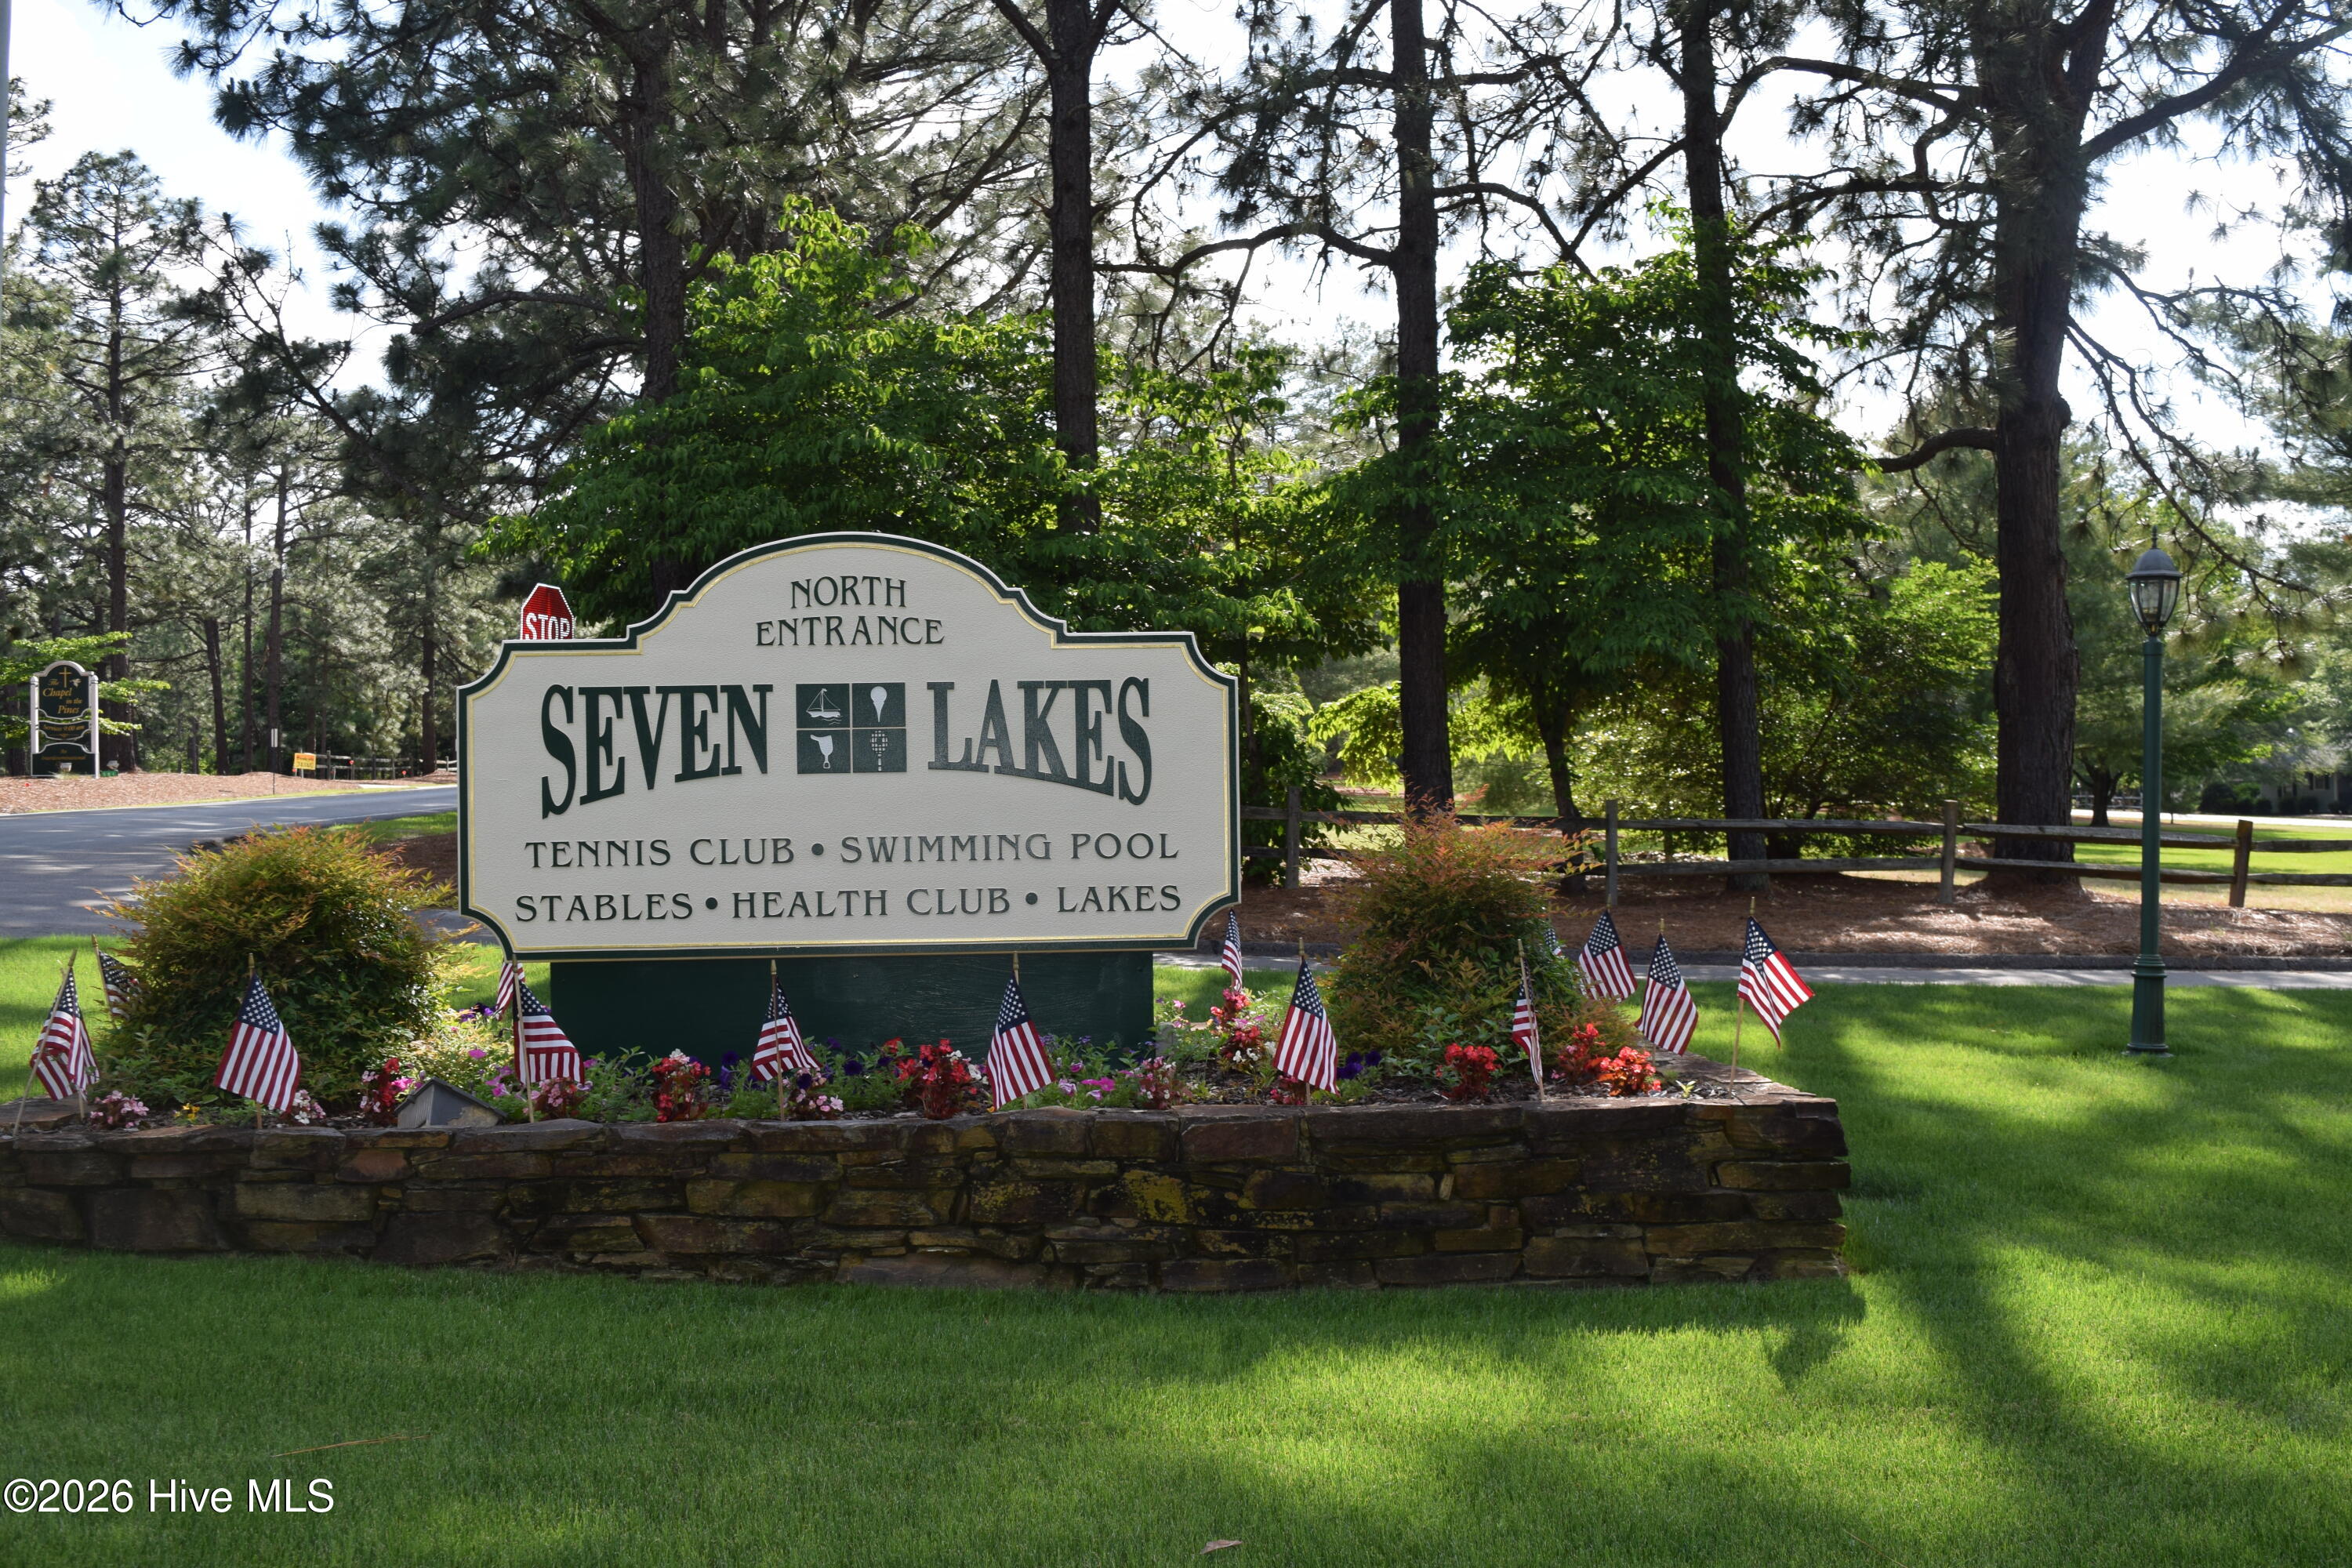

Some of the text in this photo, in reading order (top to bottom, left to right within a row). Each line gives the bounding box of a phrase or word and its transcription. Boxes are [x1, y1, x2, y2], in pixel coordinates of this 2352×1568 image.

[789, 575, 906, 609] NORTH
[526, 613, 570, 640] STOP
[756, 615, 945, 646] ENTRANCE
[42, 688, 72, 699] Chapel
[57, 705, 80, 714] Pines
[541, 676, 1152, 820] SEVEN LAKES
[524, 833, 1179, 868] TENNIS CLUB SWIMMING POOL
[515, 884, 1181, 923] STABLES HEALTH CLUB LAKES
